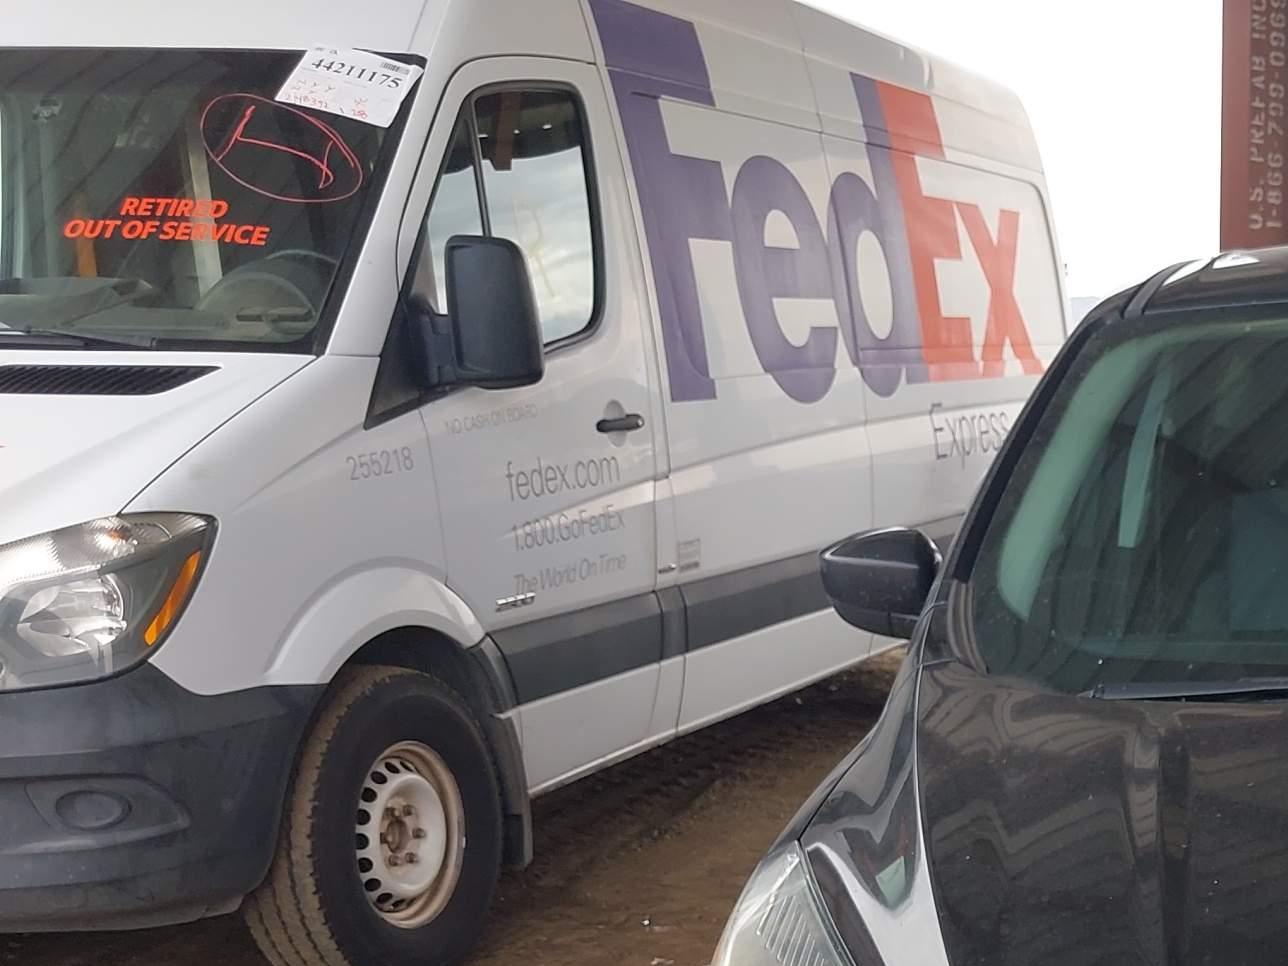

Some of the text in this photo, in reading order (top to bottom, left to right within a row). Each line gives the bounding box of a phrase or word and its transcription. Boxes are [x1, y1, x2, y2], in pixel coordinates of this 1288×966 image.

[312, 58, 403, 89] 44211175
[1250, 55, 1266, 163] PREFAB
[119, 197, 229, 218] RETIRED
[590, 0, 1045, 403] FedEx
[63, 219, 271, 246] OUT OF SERVICE
[345, 447, 414, 481] 255218
[505, 455, 621, 502] fedex.com
[513, 554, 627, 595] The World On Time
